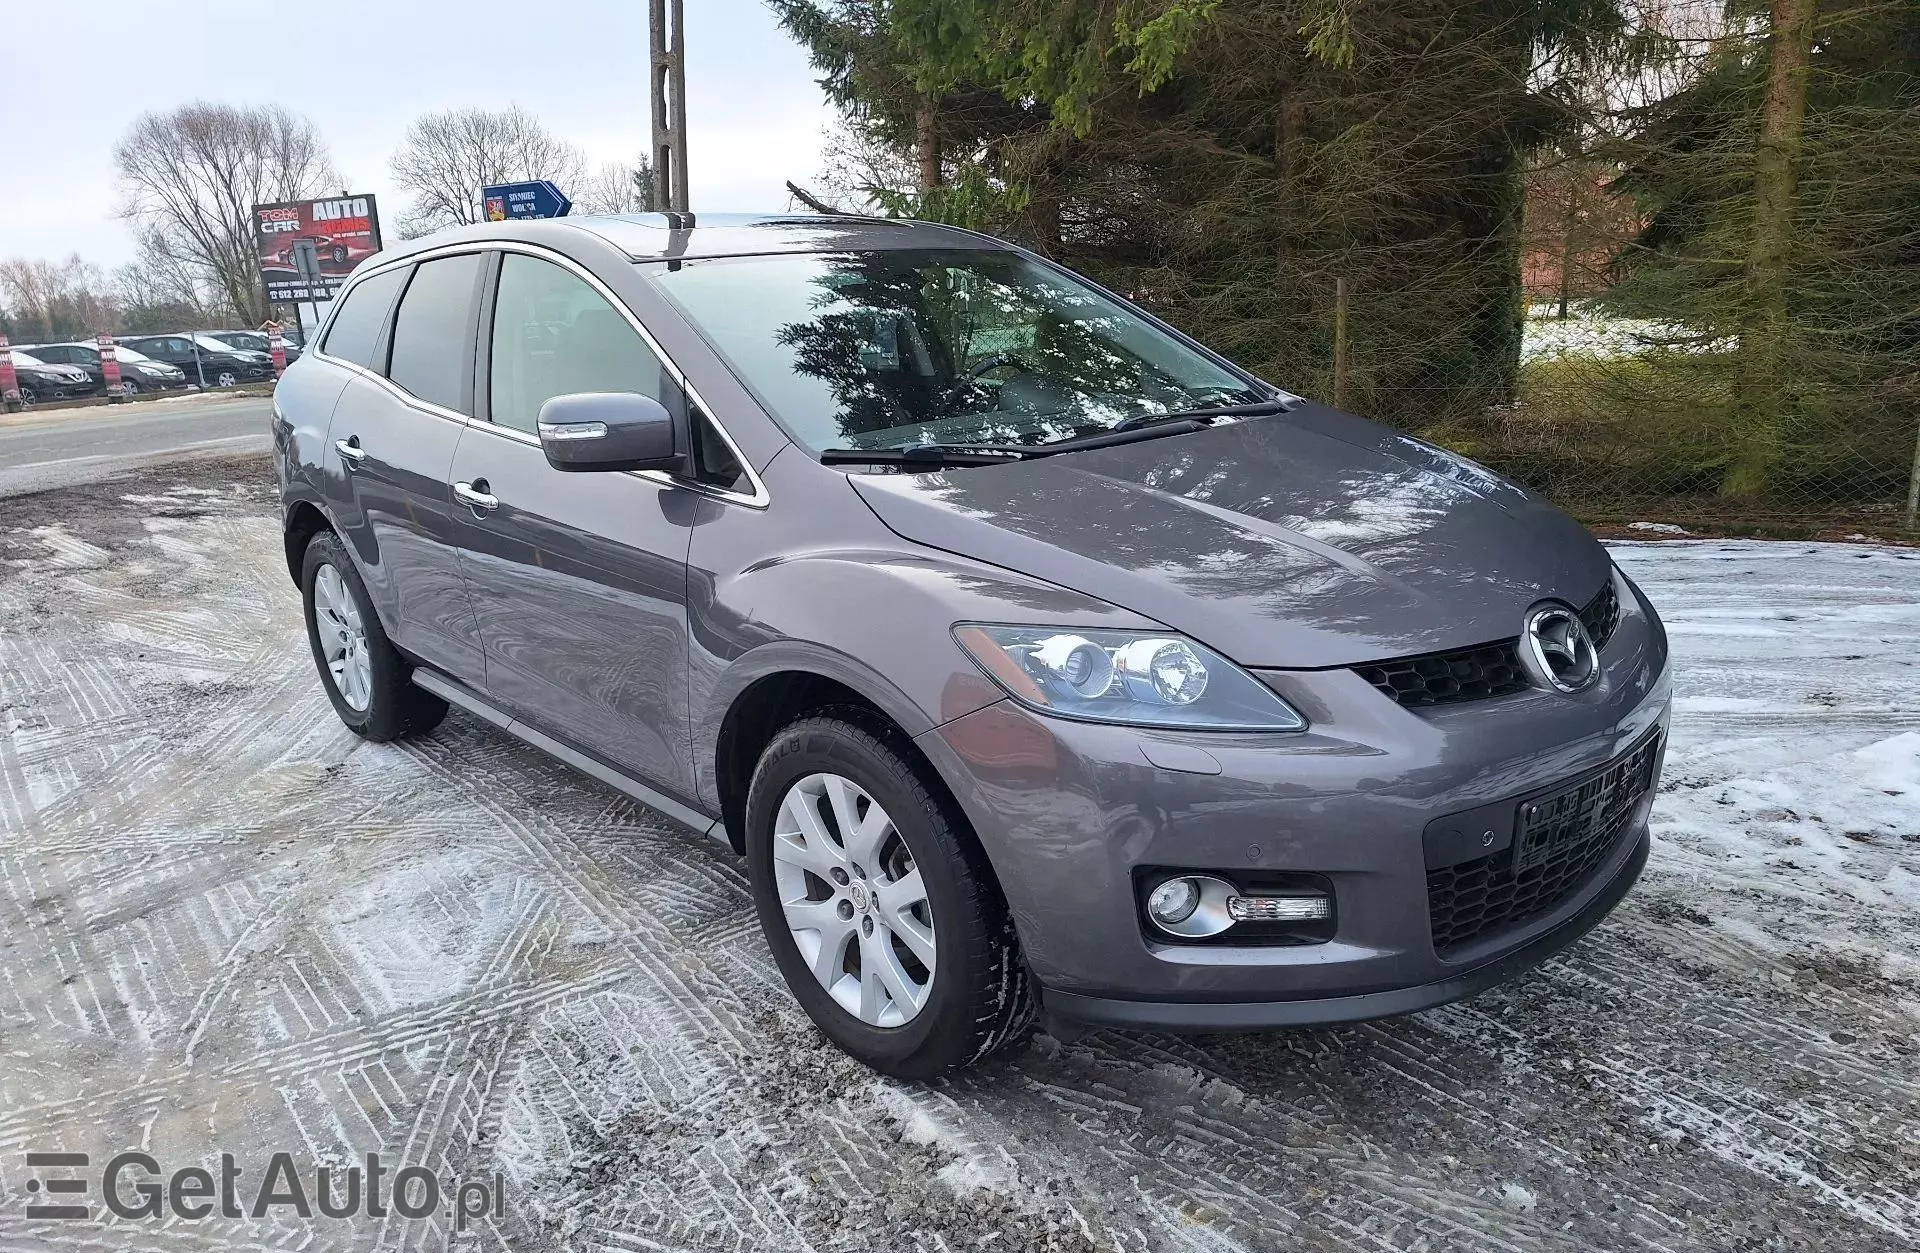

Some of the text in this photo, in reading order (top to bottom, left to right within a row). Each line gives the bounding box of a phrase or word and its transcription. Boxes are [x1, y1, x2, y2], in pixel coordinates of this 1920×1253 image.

[258, 208, 298, 222] TOM
[313, 198, 368, 220] AUTO
[260, 221, 300, 233] CAR
